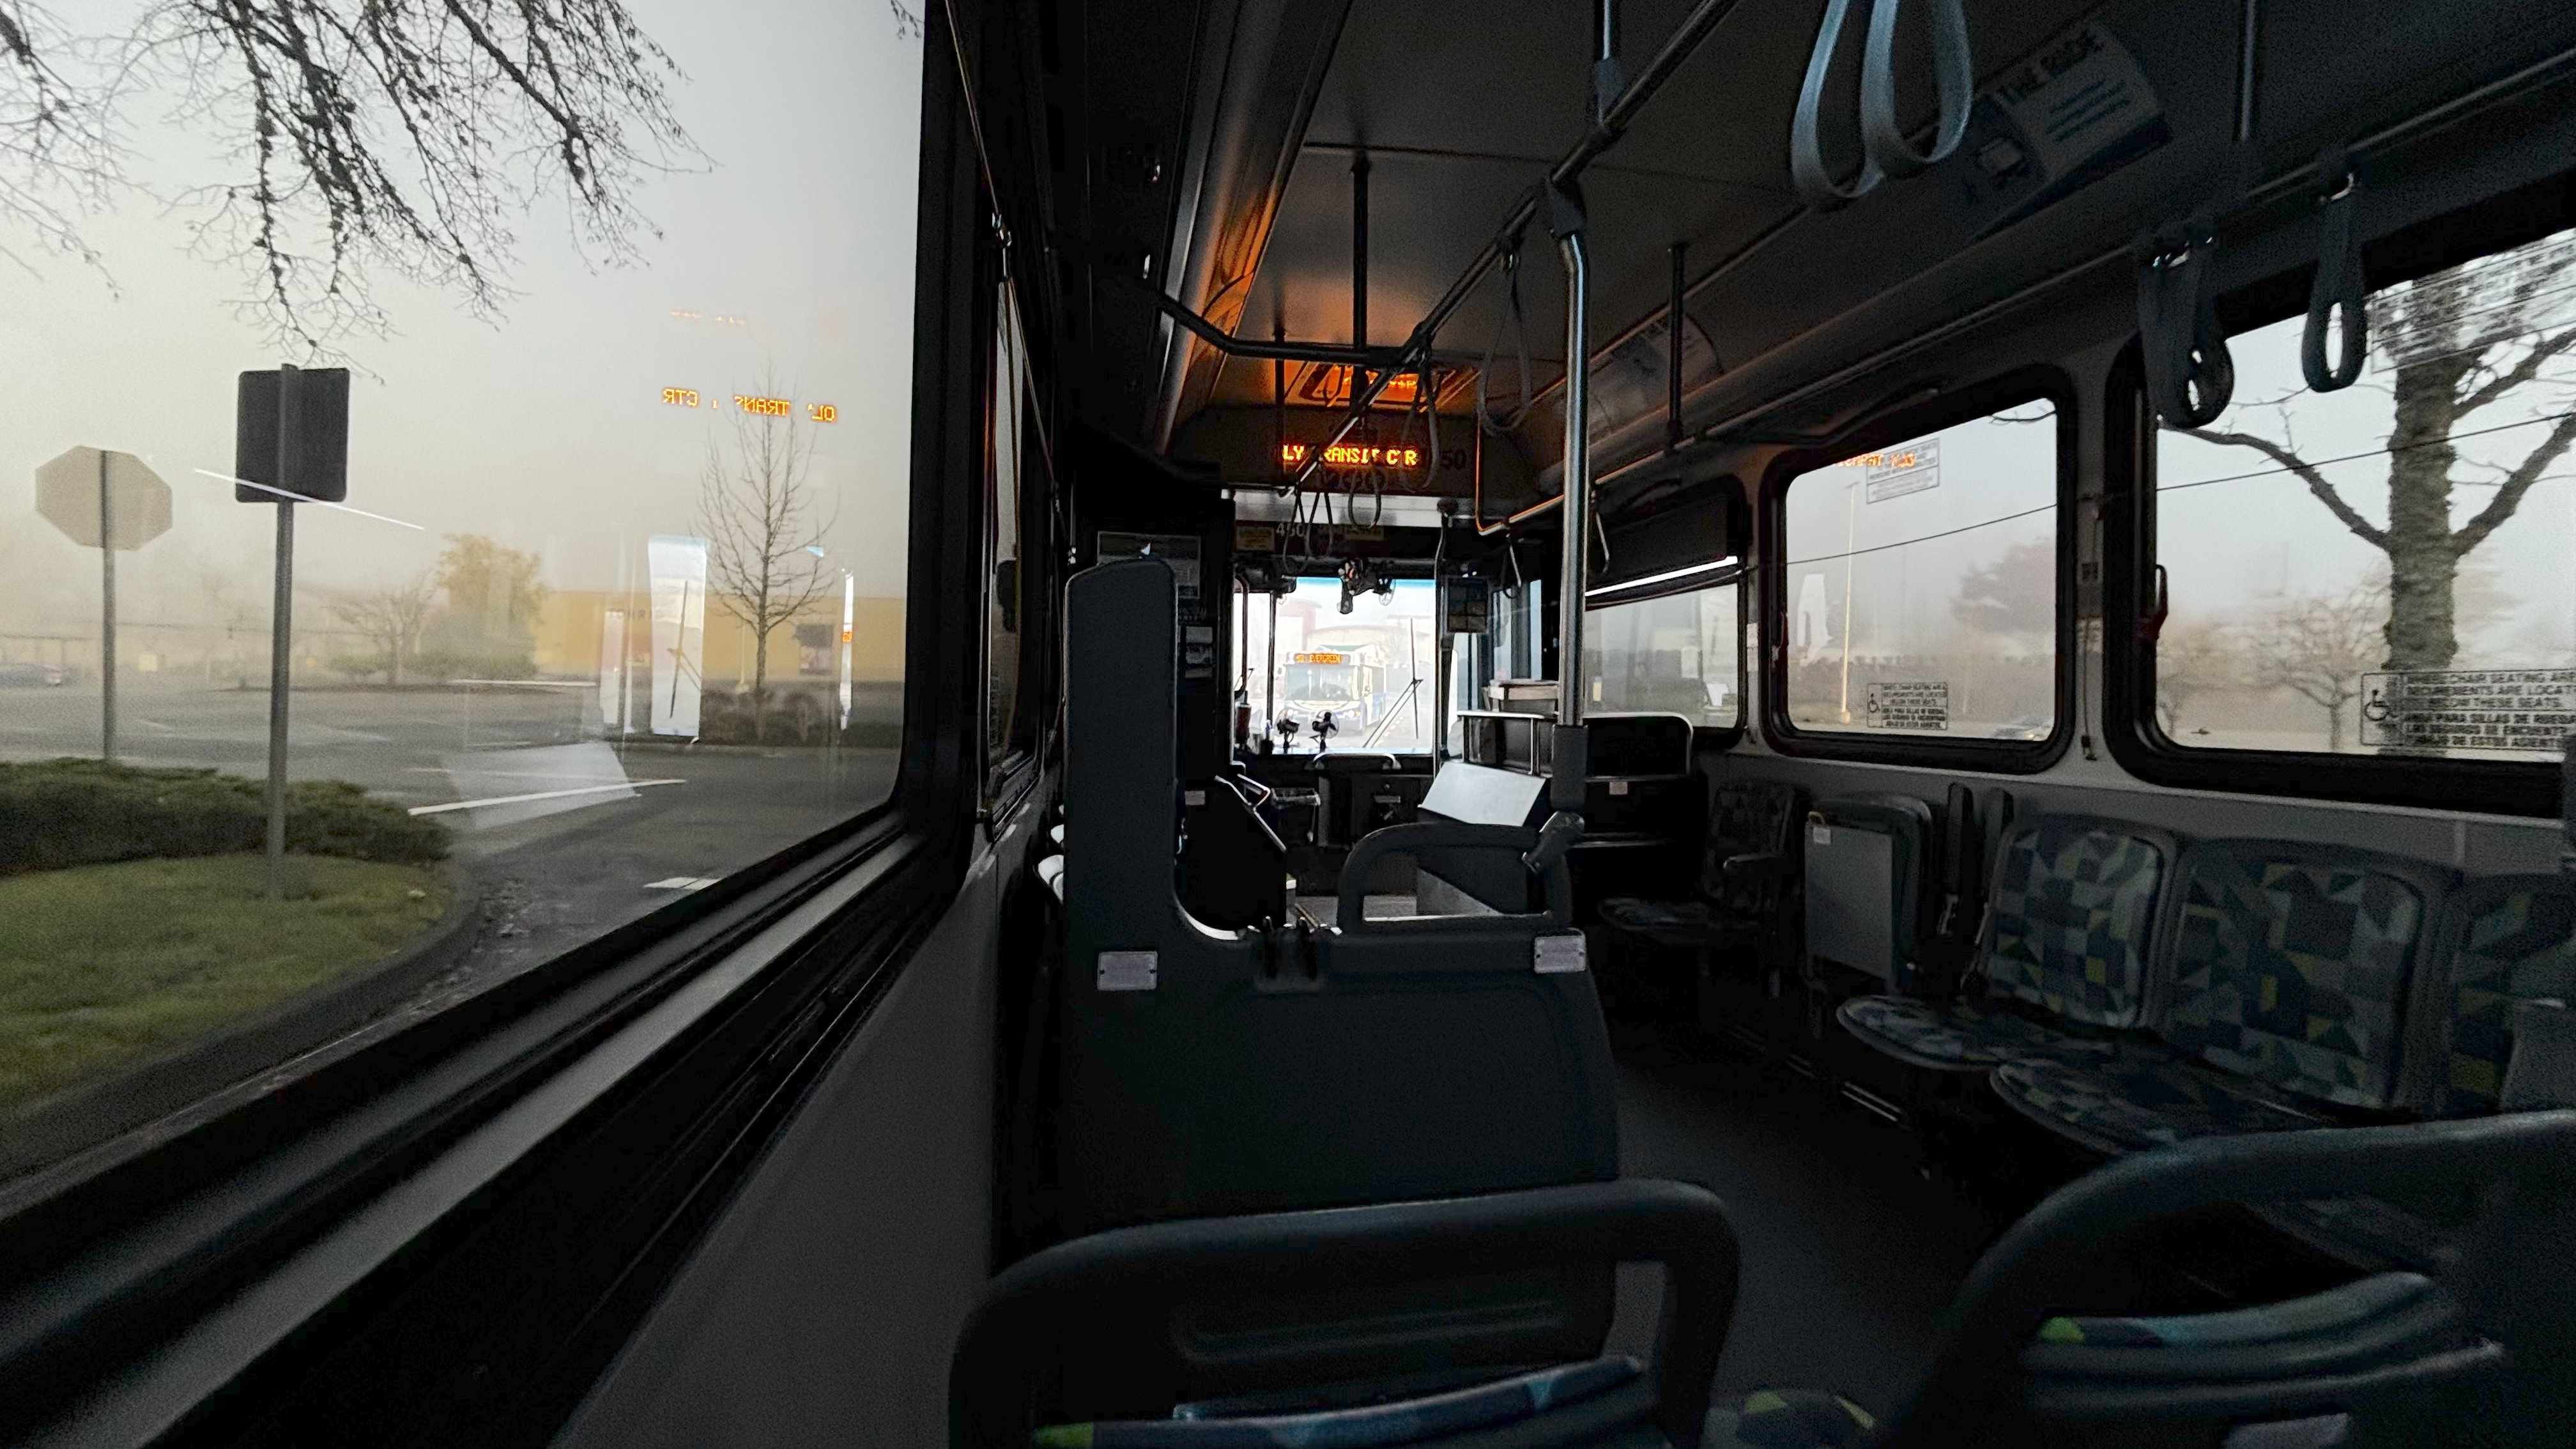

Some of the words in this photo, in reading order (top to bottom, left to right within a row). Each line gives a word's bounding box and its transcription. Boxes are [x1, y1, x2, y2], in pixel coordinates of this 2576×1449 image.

[1283, 445, 1304, 461] LY
[1386, 450, 1417, 466] CR
[1442, 450, 1466, 470] 50
[1309, 654, 1340, 664] EVERGREEN
